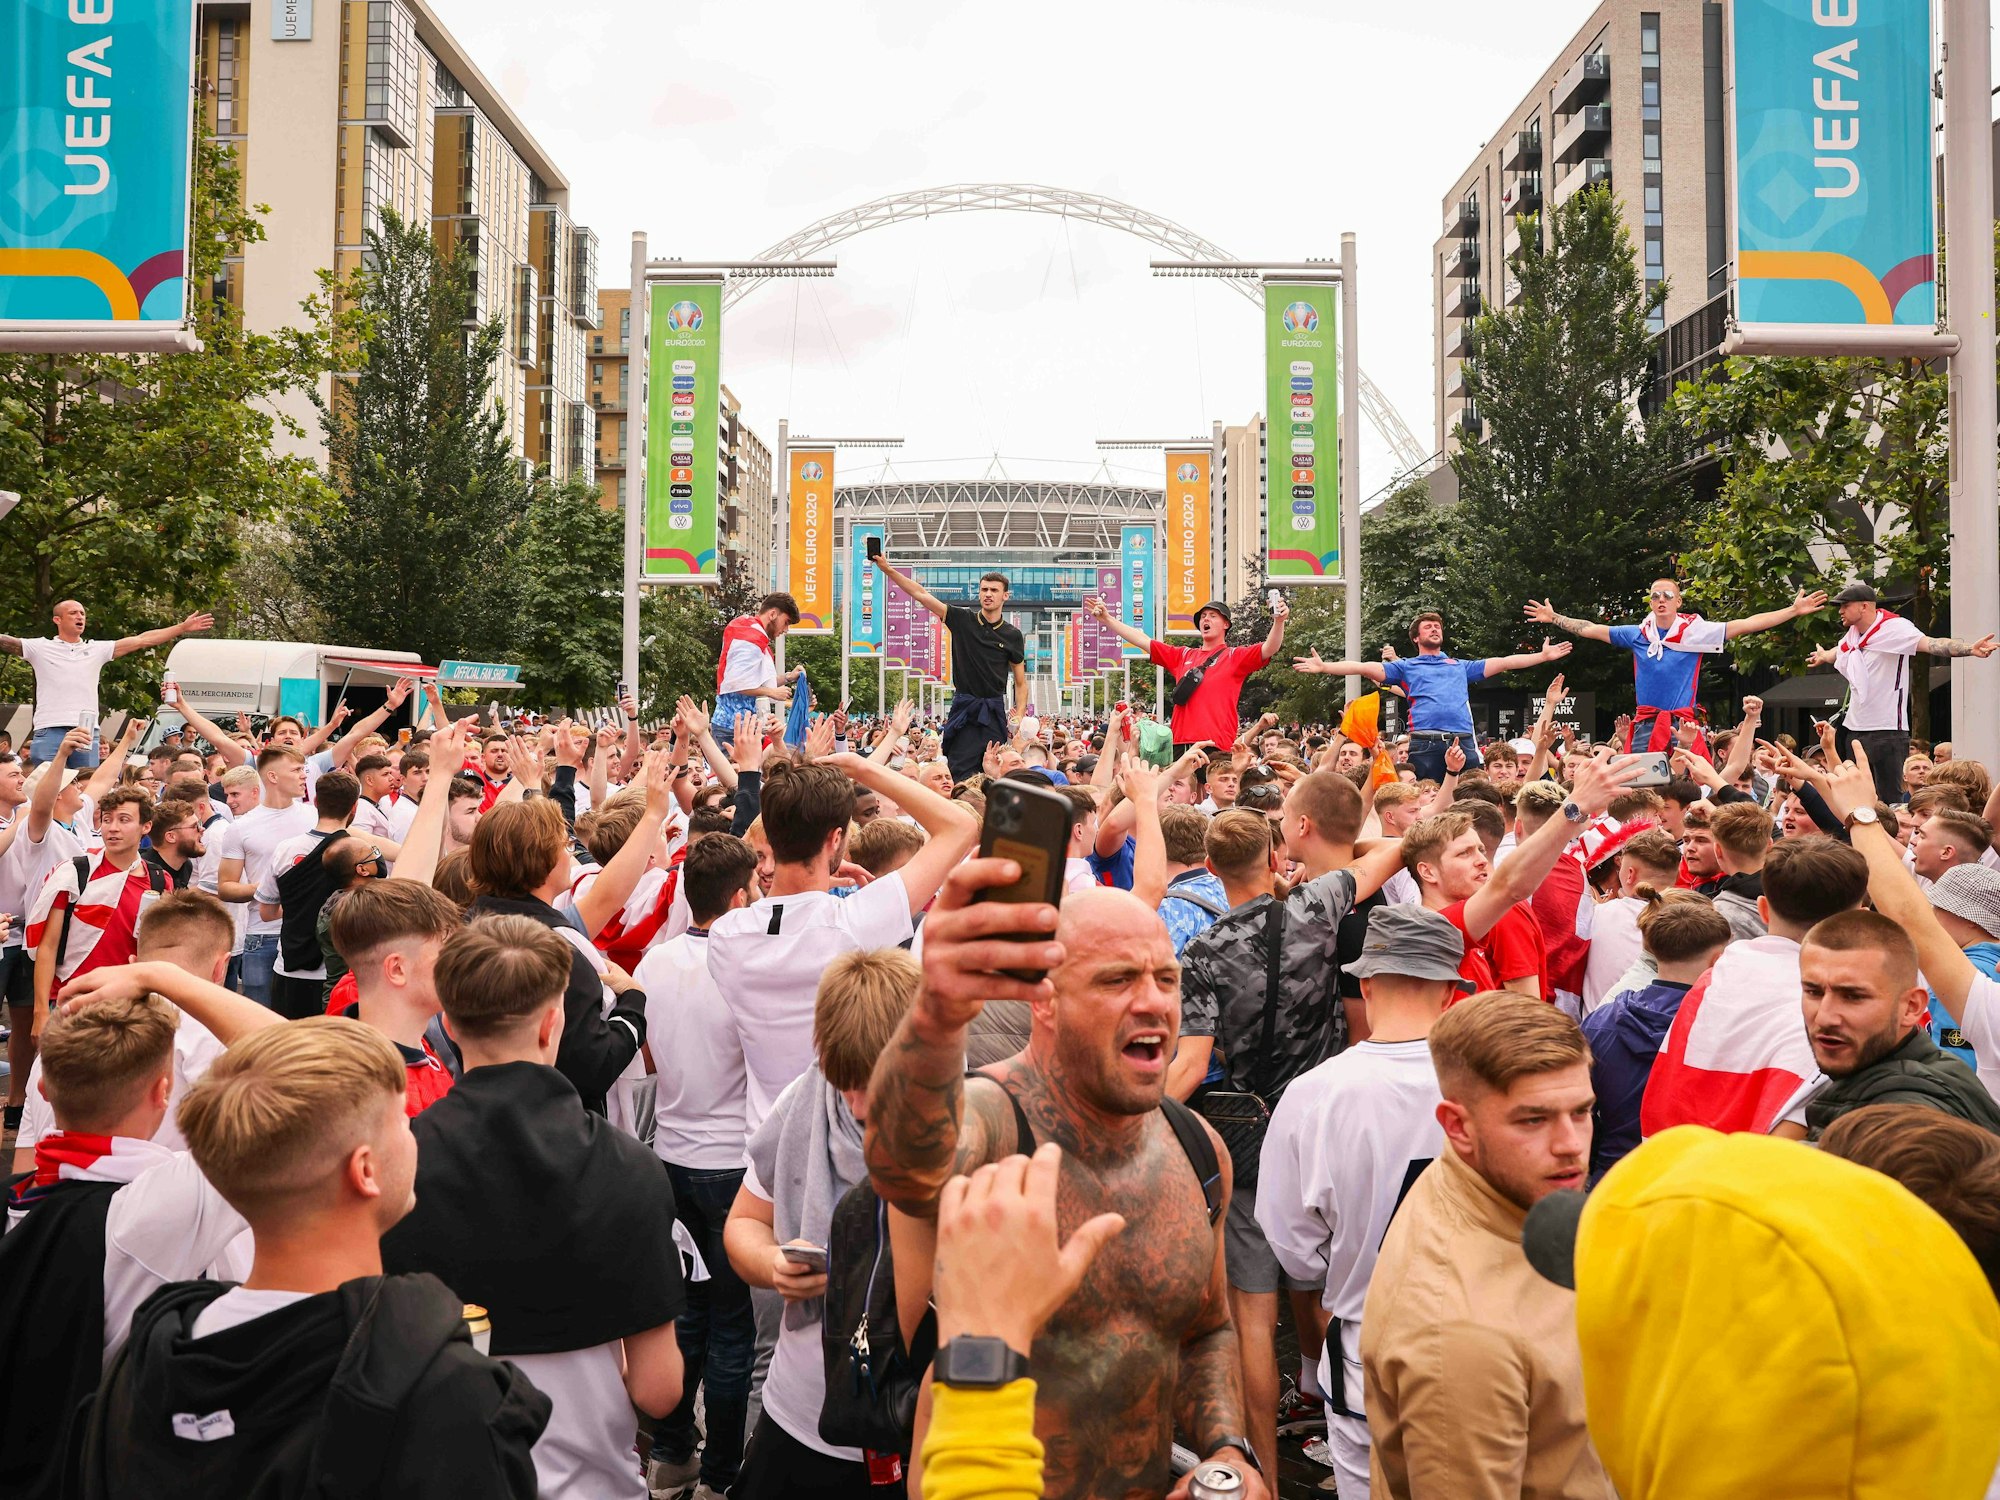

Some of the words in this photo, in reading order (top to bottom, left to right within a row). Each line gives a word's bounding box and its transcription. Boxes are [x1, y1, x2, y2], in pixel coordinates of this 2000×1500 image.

[64, 35, 113, 195] UEFA
[1812, 38, 1860, 198] UEFA
[805, 493, 818, 527] 2020
[1183, 494, 1195, 528] 2020
[805, 528, 817, 566] EURO
[1183, 529, 1195, 567] EURO
[805, 567, 817, 603] UEFA
[1183, 568, 1195, 604] UEFA
[453, 665, 481, 680] OFFICIAL
[480, 667, 494, 681] FAN
[491, 668, 508, 681] SHOP
[201, 690, 254, 699] MERCHANDISE
[1532, 697, 1577, 706] WELEY
[1532, 706, 1574, 715] FAARK
